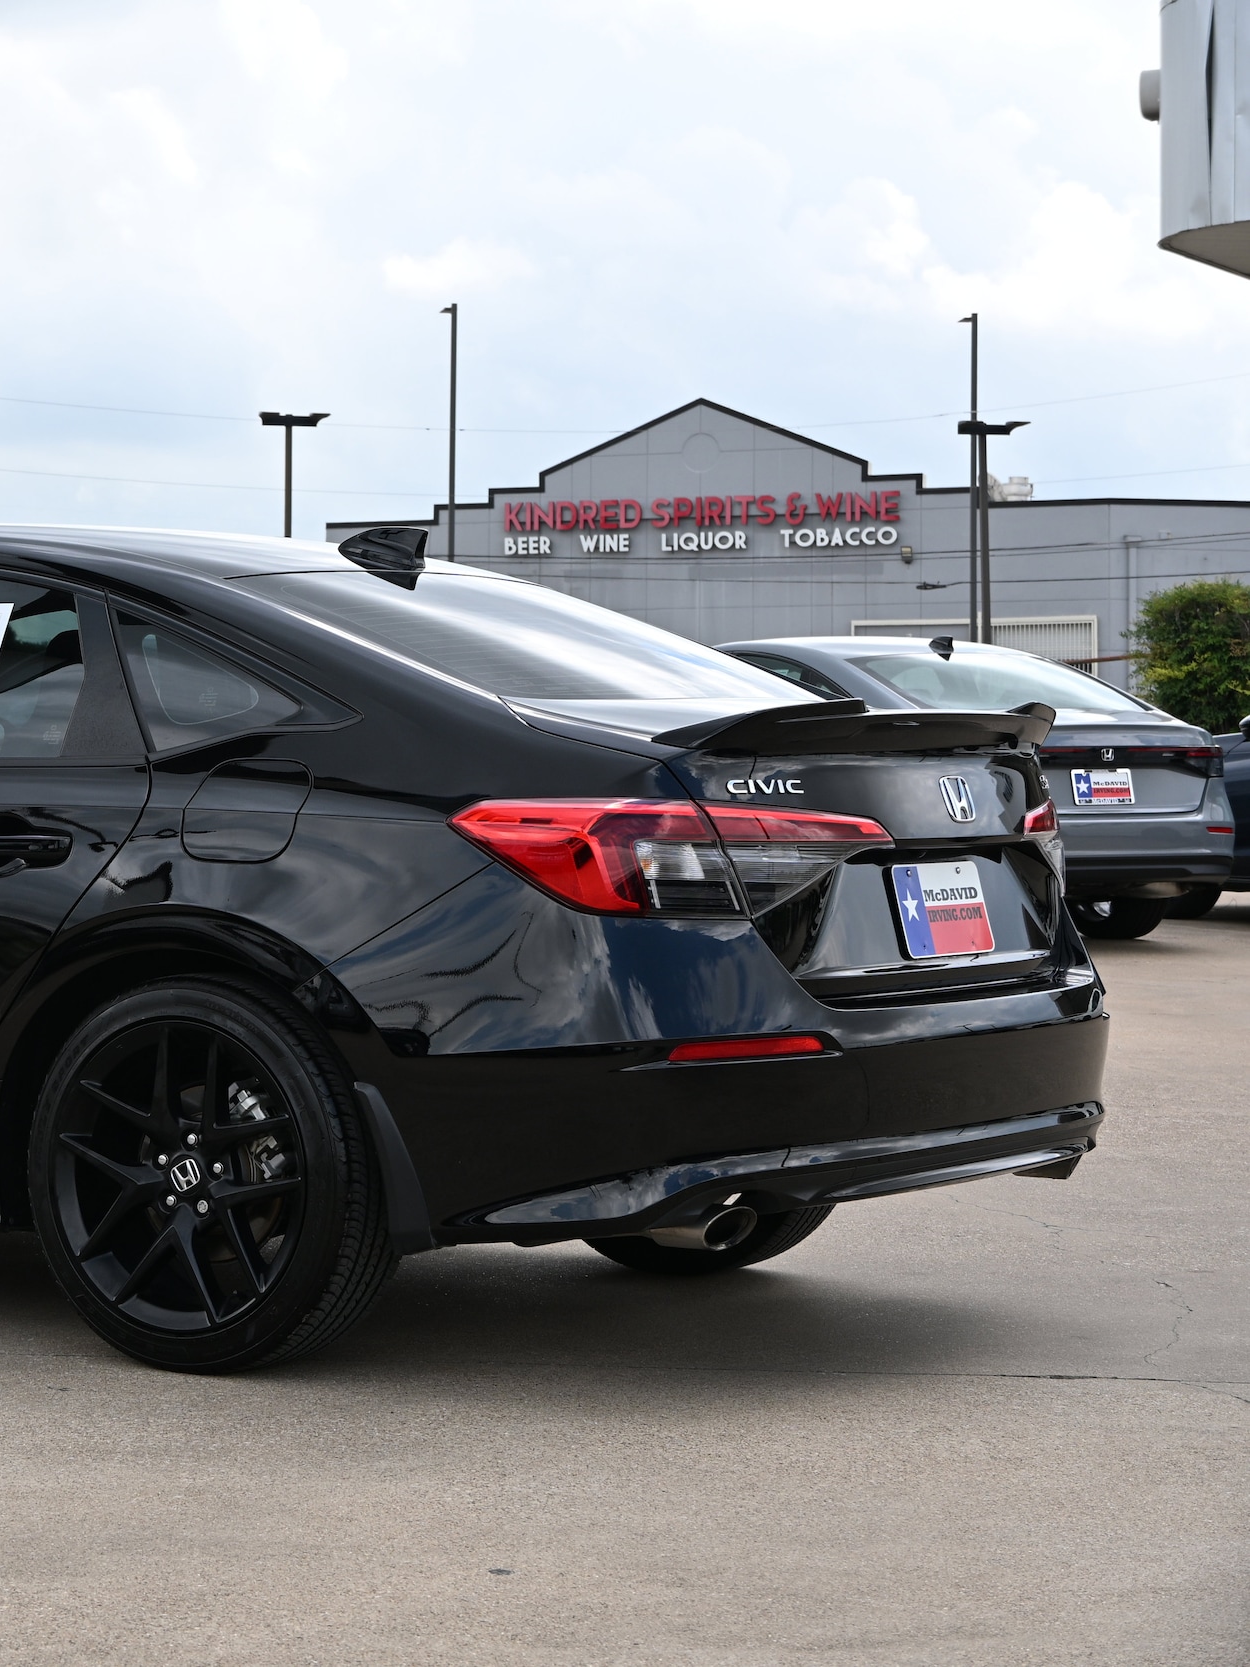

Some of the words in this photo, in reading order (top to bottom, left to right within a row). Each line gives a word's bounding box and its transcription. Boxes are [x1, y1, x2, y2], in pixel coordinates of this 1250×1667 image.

[503, 499, 643, 532] KINDRED
[651, 494, 776, 529] SPIRITS
[784, 491, 808, 526] &
[814, 490, 901, 522] WINE
[503, 536, 551, 556] BEER
[579, 533, 630, 553] WINE
[661, 530, 747, 552] LIQUOR
[780, 526, 898, 548] TOBACCO
[726, 779, 805, 794] CIVIC
[923, 886, 979, 902] McDAVID
[927, 906, 983, 923] IRVING.COM
